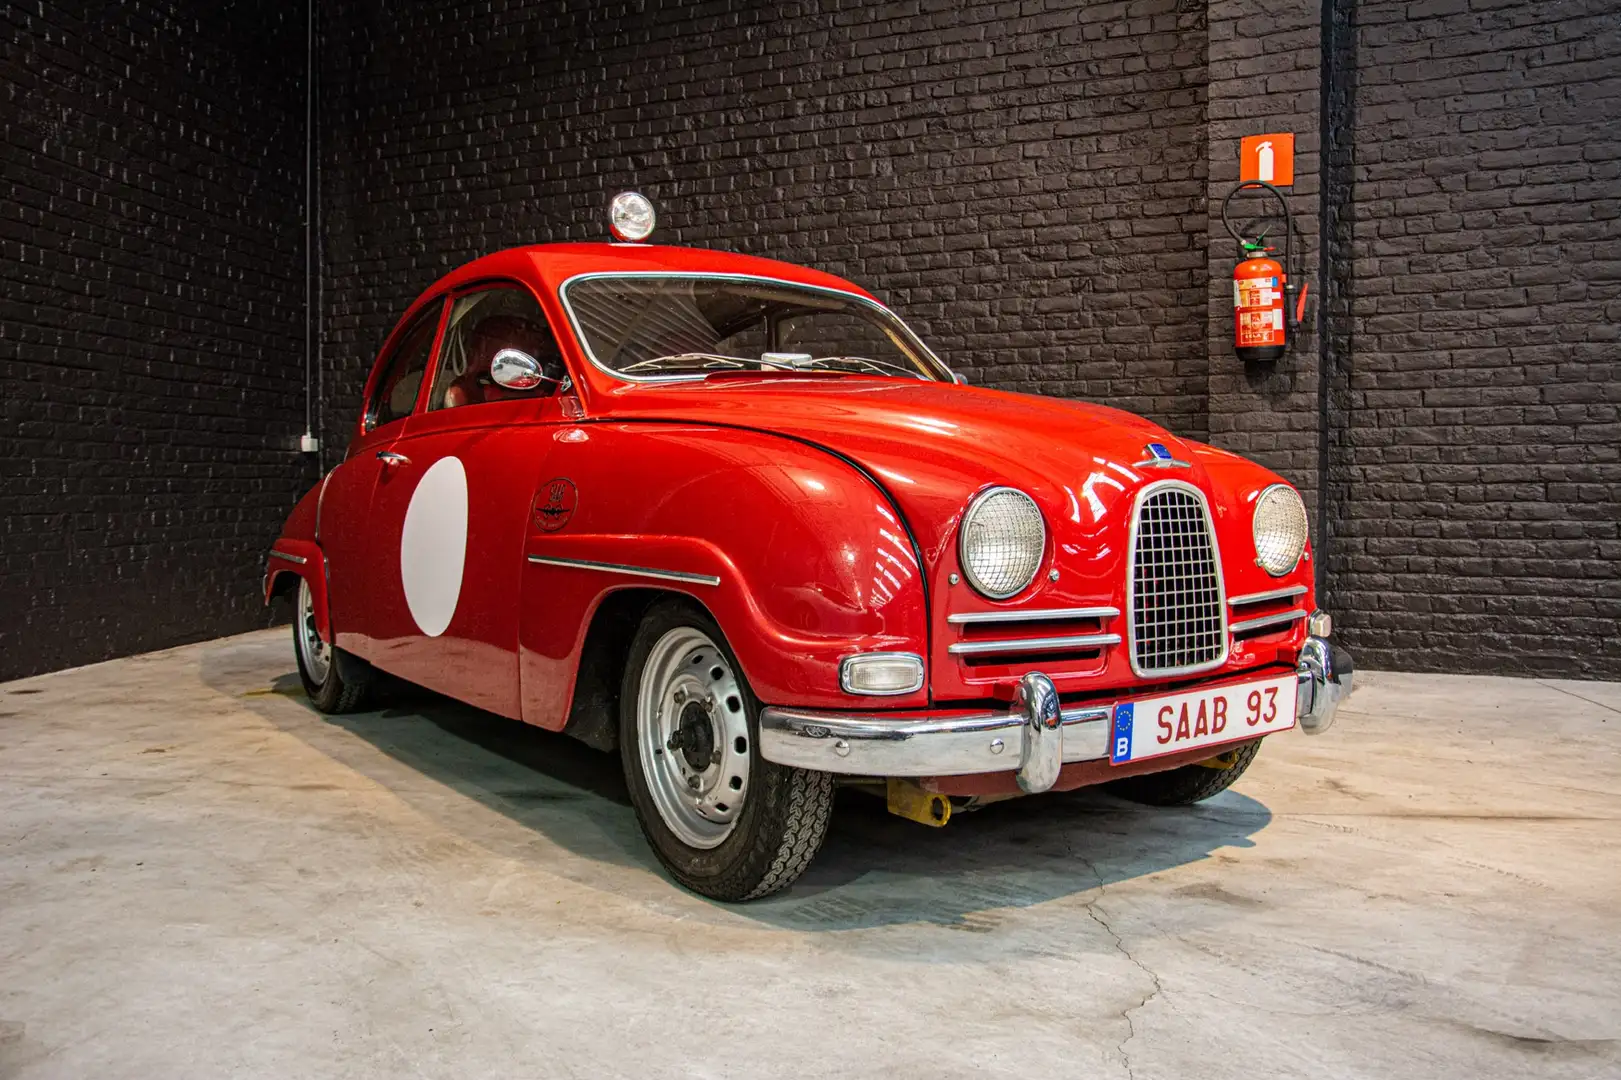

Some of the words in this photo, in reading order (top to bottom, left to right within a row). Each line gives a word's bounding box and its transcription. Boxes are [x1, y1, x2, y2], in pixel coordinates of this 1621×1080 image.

[1156, 696, 1228, 745] SAAB
[1246, 686, 1279, 727] 93
[1116, 737, 1129, 757] B
